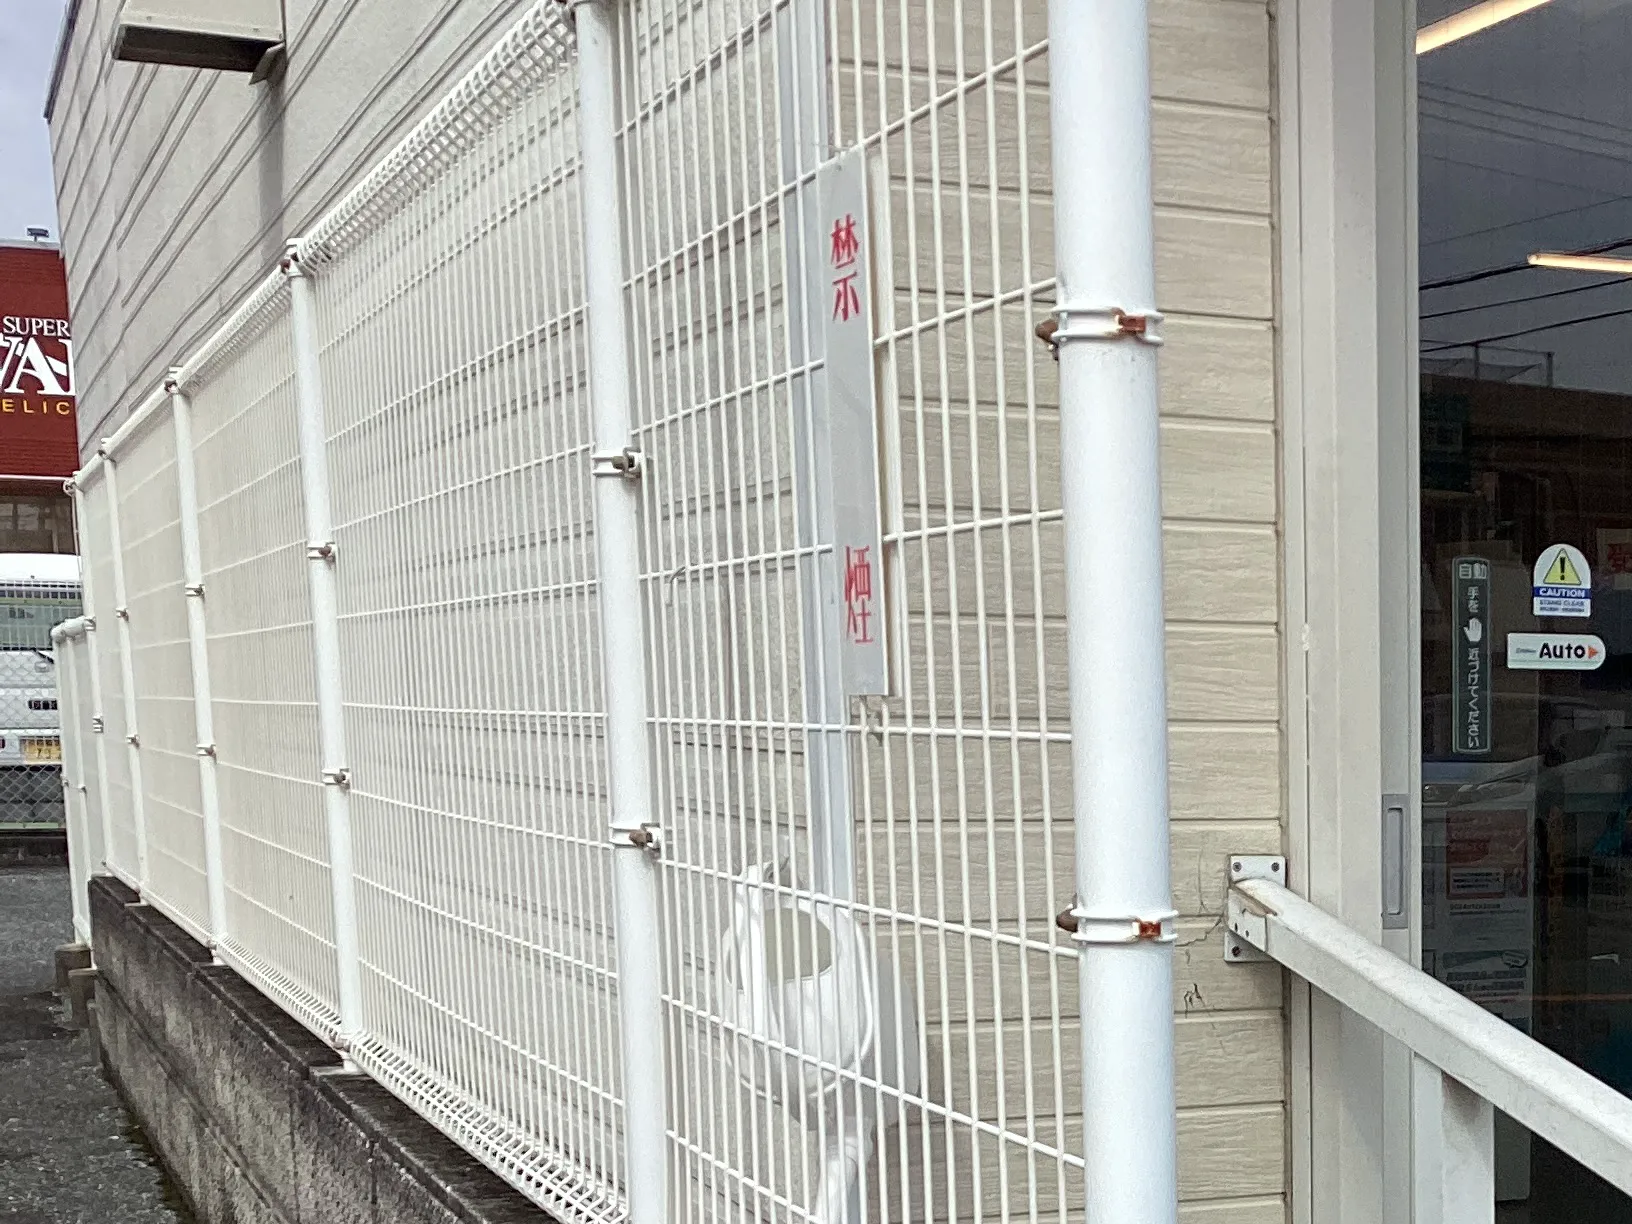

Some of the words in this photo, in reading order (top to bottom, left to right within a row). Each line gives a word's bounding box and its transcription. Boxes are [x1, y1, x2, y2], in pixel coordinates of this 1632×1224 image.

[3, 315, 71, 338] SUPER
[1539, 588, 1586, 598] CAUTION
[1539, 642, 1586, 659] Auto
